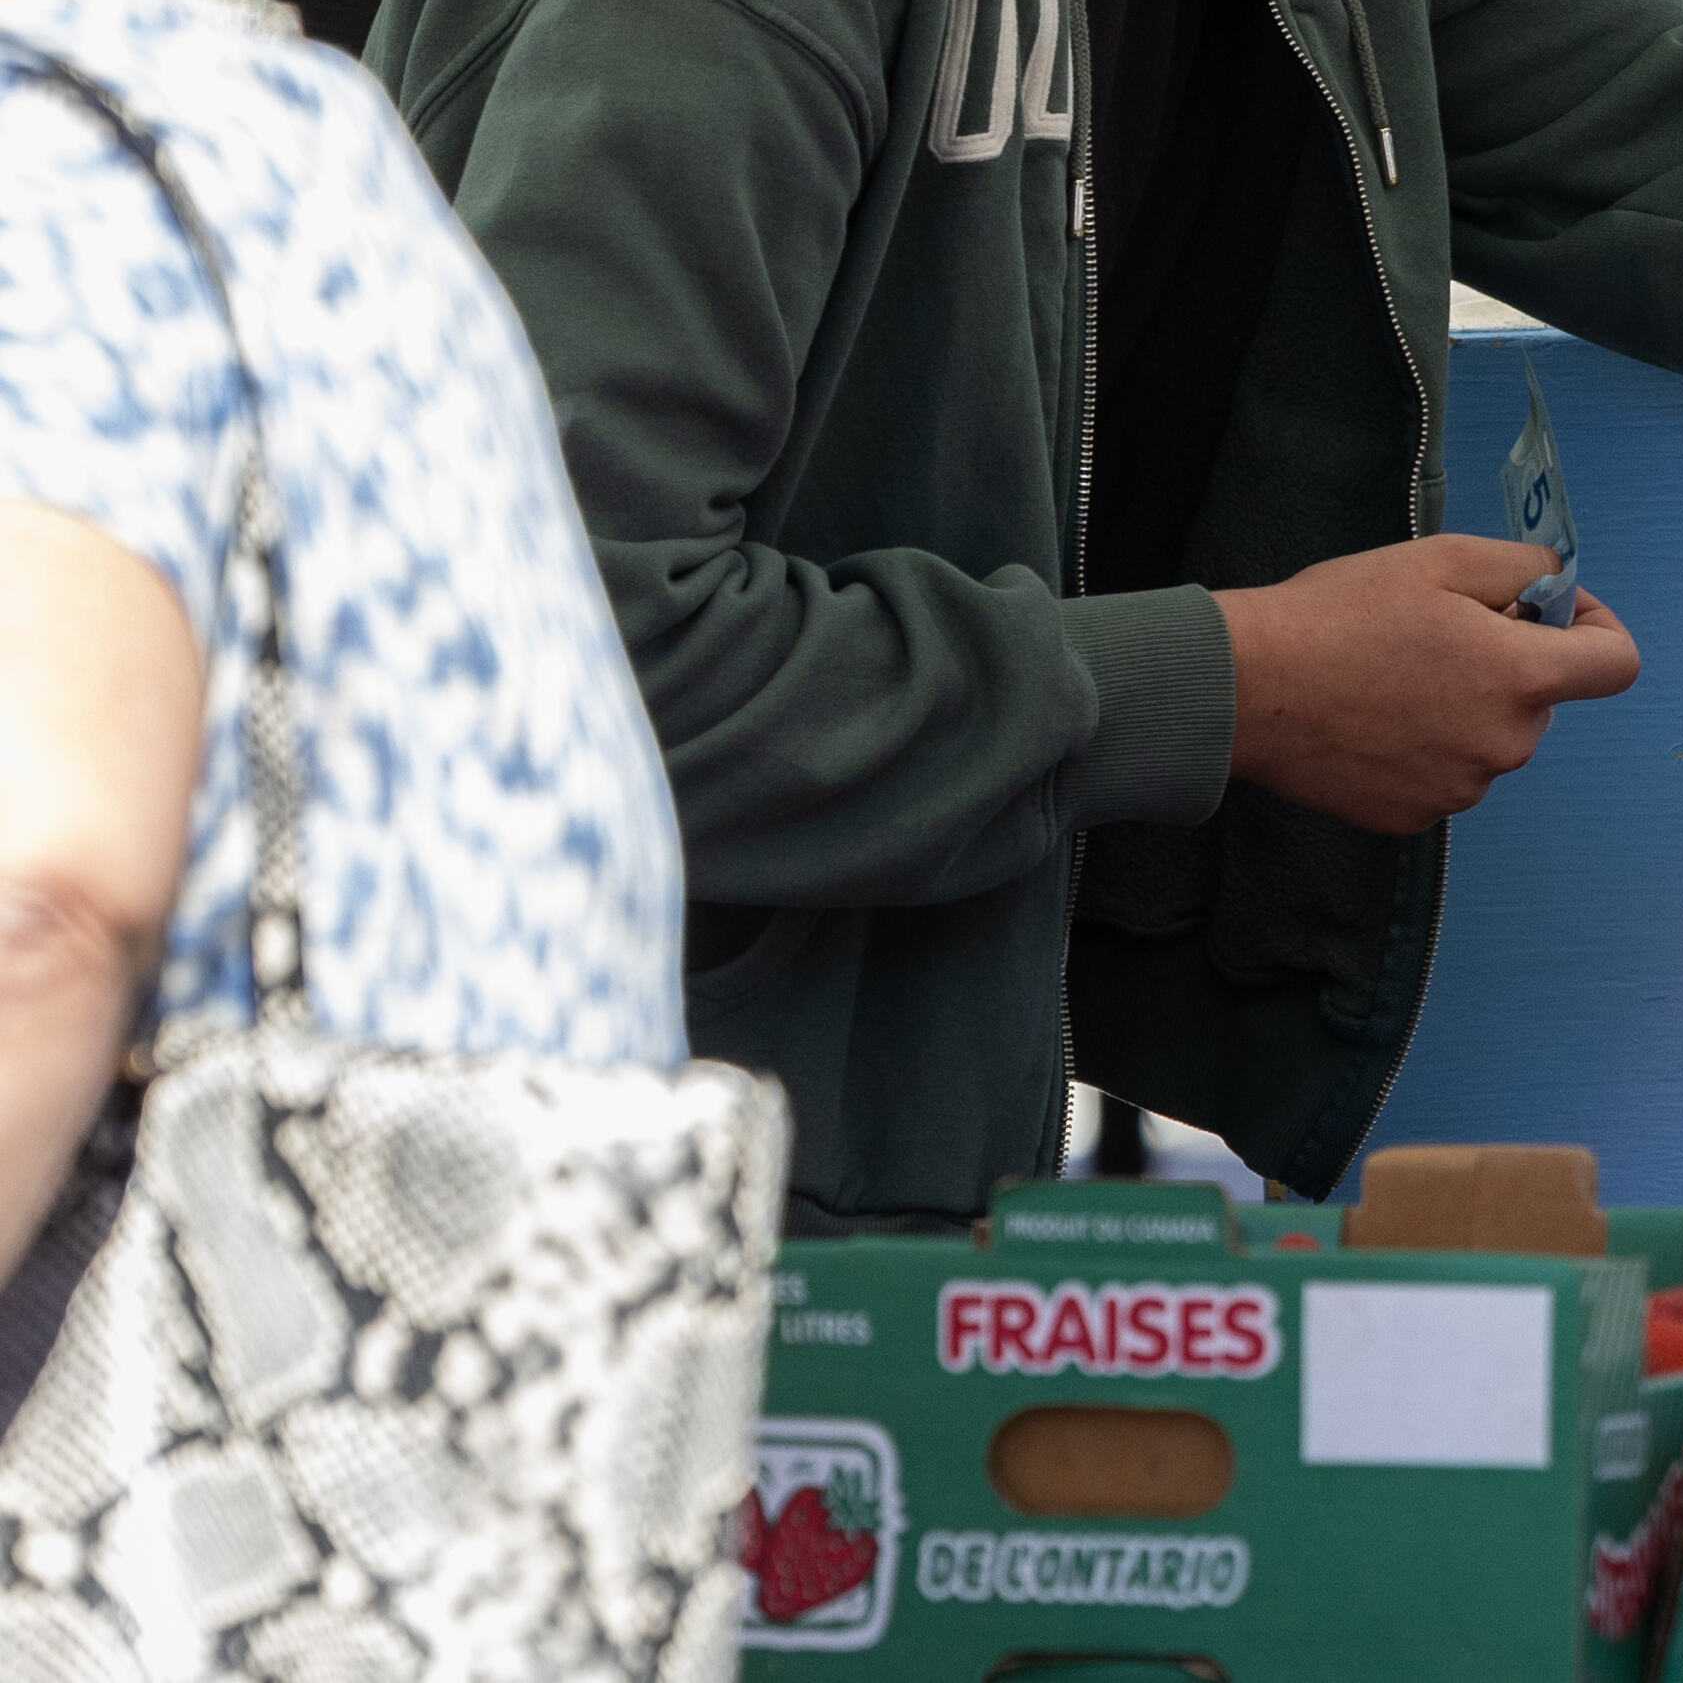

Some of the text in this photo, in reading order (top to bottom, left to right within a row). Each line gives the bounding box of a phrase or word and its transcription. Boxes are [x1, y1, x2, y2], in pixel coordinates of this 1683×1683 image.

[1524, 470, 1551, 531] 5
[944, 1288, 1272, 1372] FRAISES
[924, 1538, 992, 1593] DE
